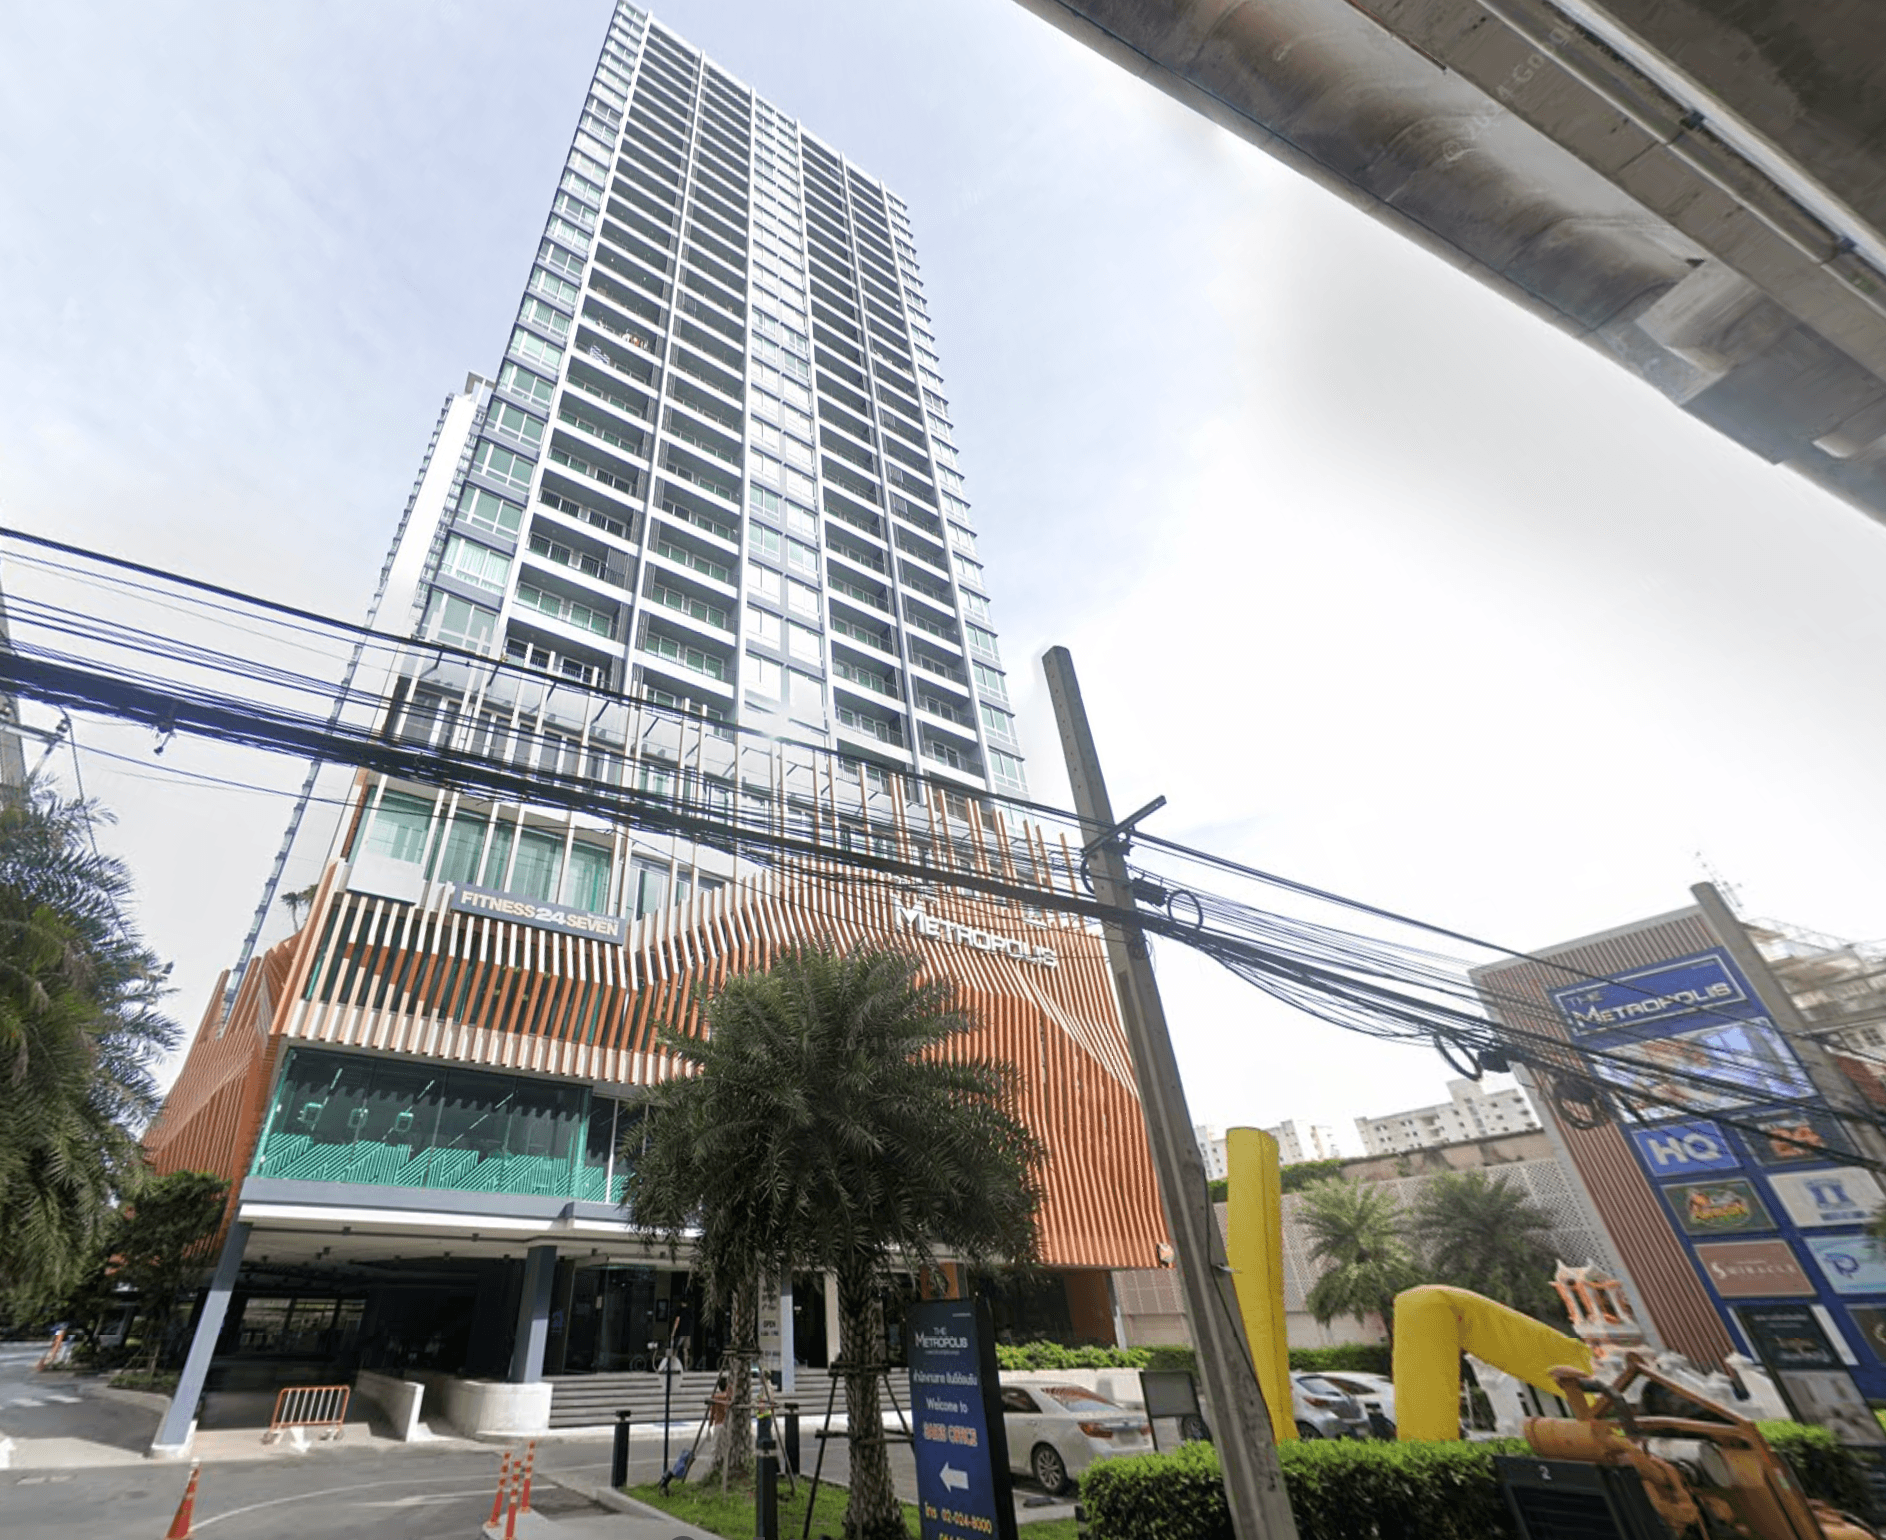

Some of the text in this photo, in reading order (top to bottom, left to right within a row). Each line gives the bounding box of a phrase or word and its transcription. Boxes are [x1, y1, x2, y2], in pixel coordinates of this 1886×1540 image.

[892, 897, 1058, 968] METROPOLIS
[1566, 990, 1603, 1007] THE
[1571, 982, 1732, 1028] METROPOLIS
[1646, 1133, 1723, 1166] HQ
[915, 1331, 968, 1348] METROPOLIS
[925, 1396, 968, 1414] Welcome to
[1538, 1465, 1552, 1481] 2
